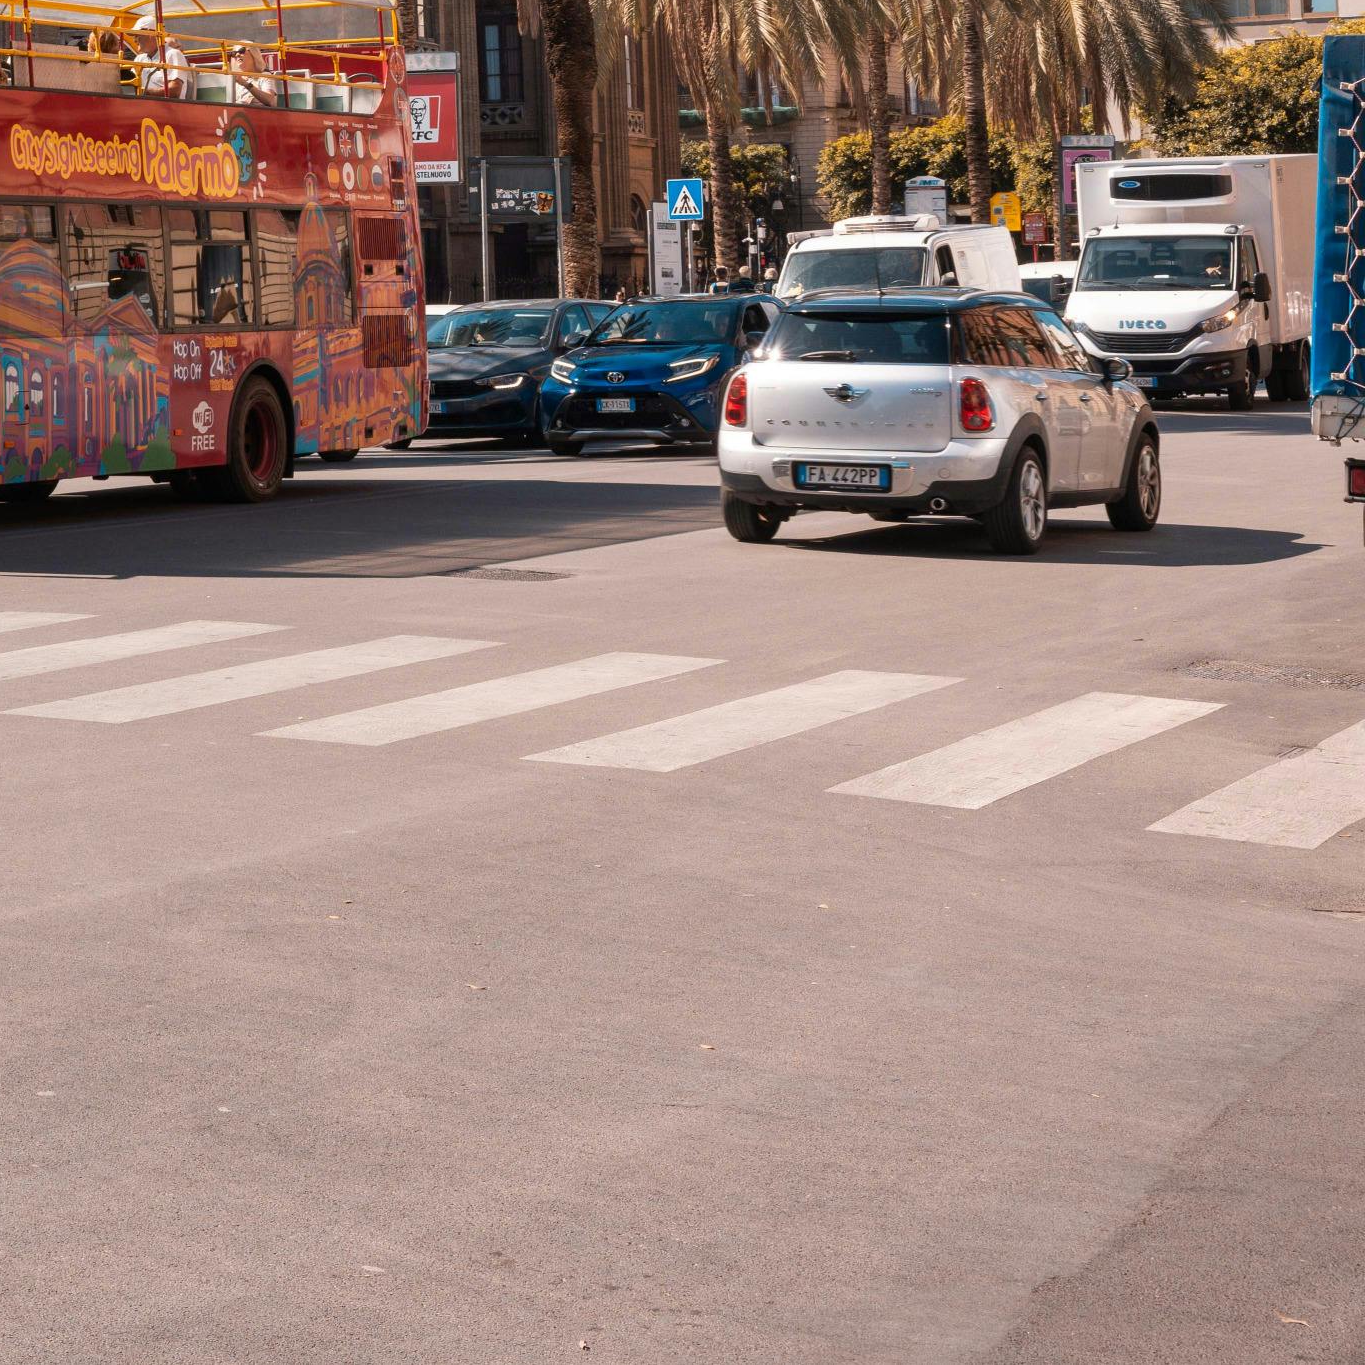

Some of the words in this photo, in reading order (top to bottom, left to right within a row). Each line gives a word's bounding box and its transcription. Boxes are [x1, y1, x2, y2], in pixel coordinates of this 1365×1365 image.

[140, 117, 240, 198] Palermo
[1119, 319, 1166, 329] IVECO
[173, 340, 188, 359] Hop
[189, 339, 200, 357] On
[173, 363, 189, 381] Hop
[190, 363, 202, 380] Off
[210, 349, 224, 377] 24
[191, 434, 215, 451] FREE
